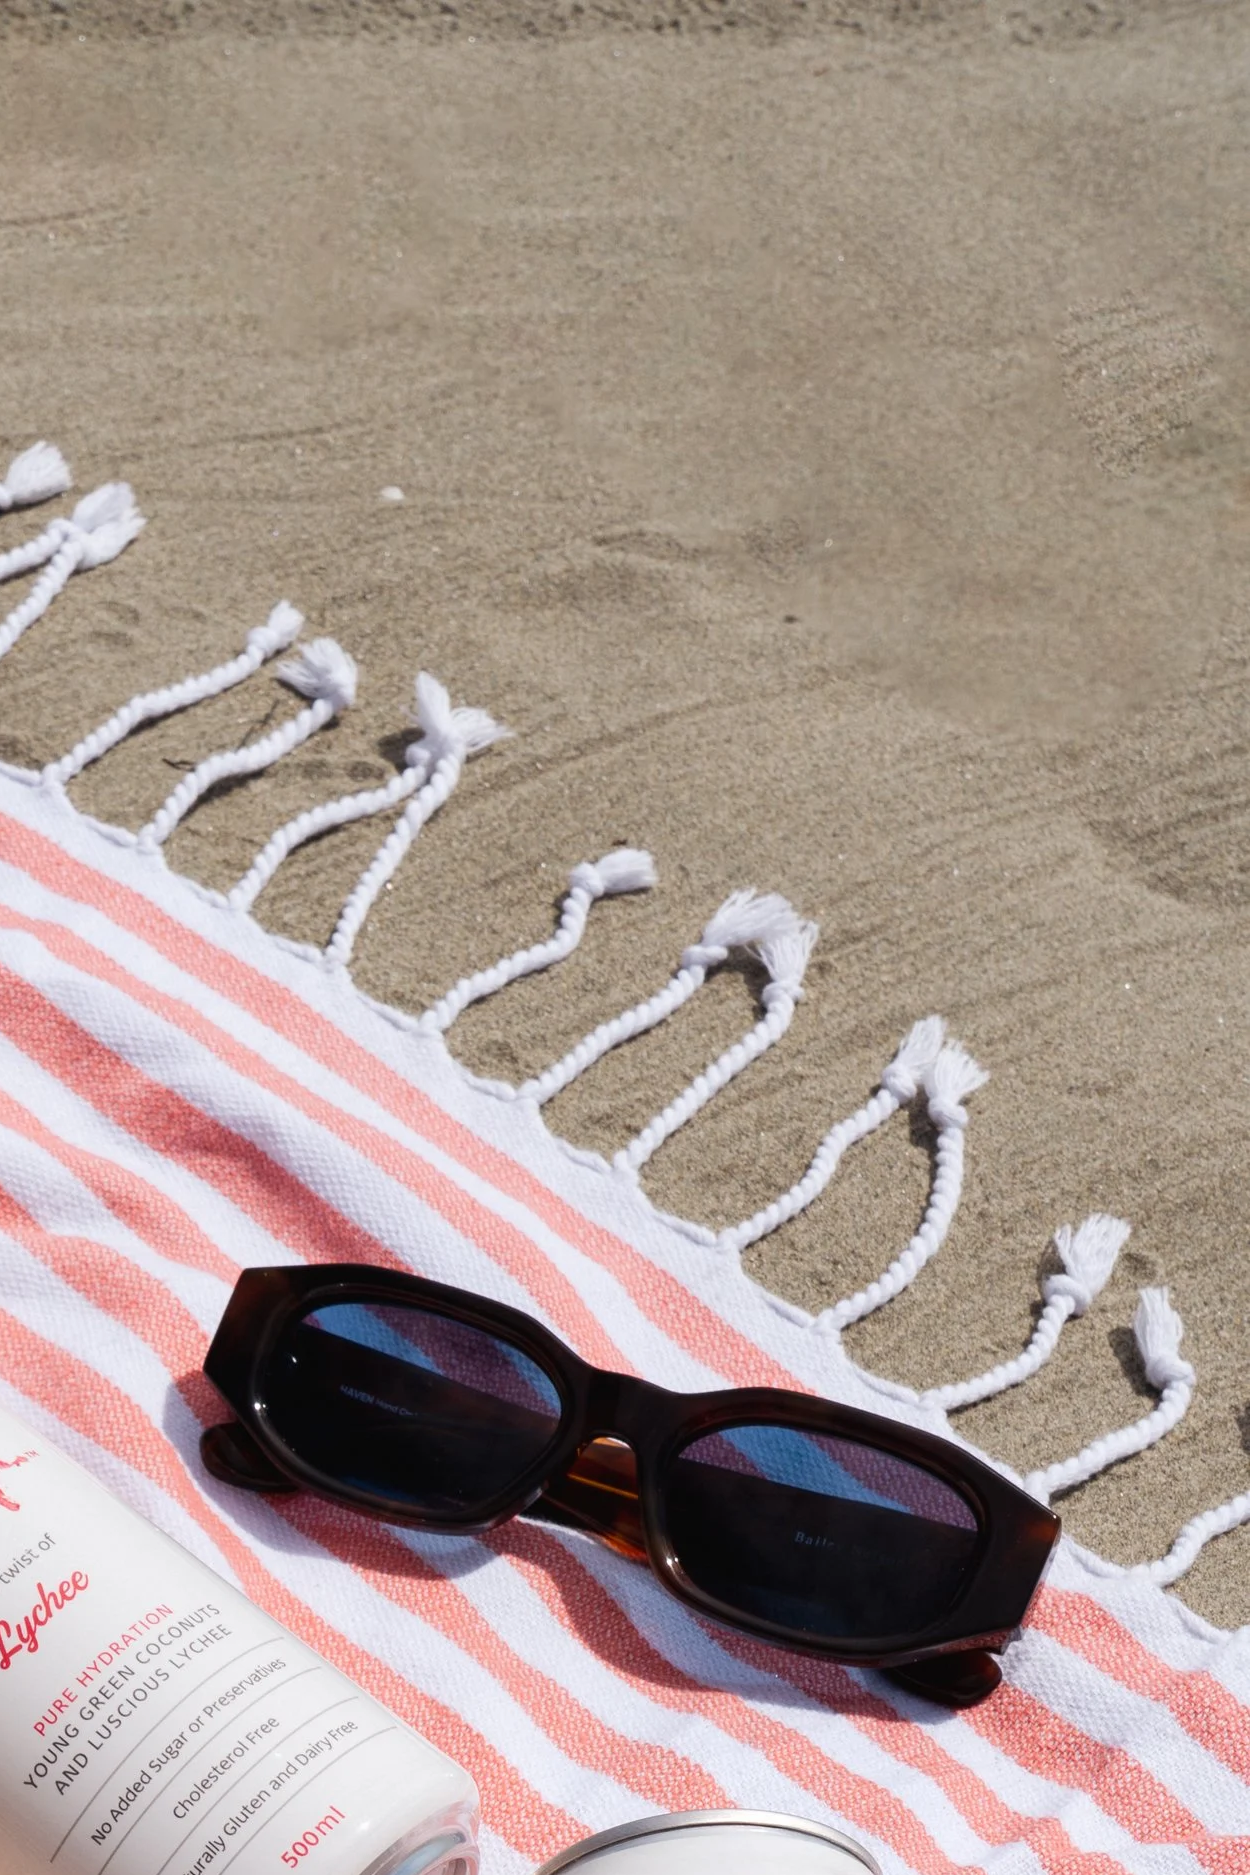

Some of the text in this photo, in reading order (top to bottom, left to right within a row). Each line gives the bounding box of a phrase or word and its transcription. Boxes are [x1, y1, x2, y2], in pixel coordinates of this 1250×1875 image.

[38, 1532, 57, 1553] of
[23, 1603, 221, 1791] YOUNG GREEN COCONUTS
[33, 1603, 174, 1738] PURE HYDRATION
[55, 1623, 233, 1796] AND LUSCIOUS LYCHEE
[90, 1656, 287, 1847] No Added Sugar or Preservatives
[173, 1715, 280, 1820] Cholesterol Free
[223, 1788, 271, 1838] Gluten
[269, 1761, 298, 1791] and
[296, 1732, 336, 1767] Dairy
[328, 1718, 358, 1743] Free
[280, 1805, 346, 1869] 500ml
